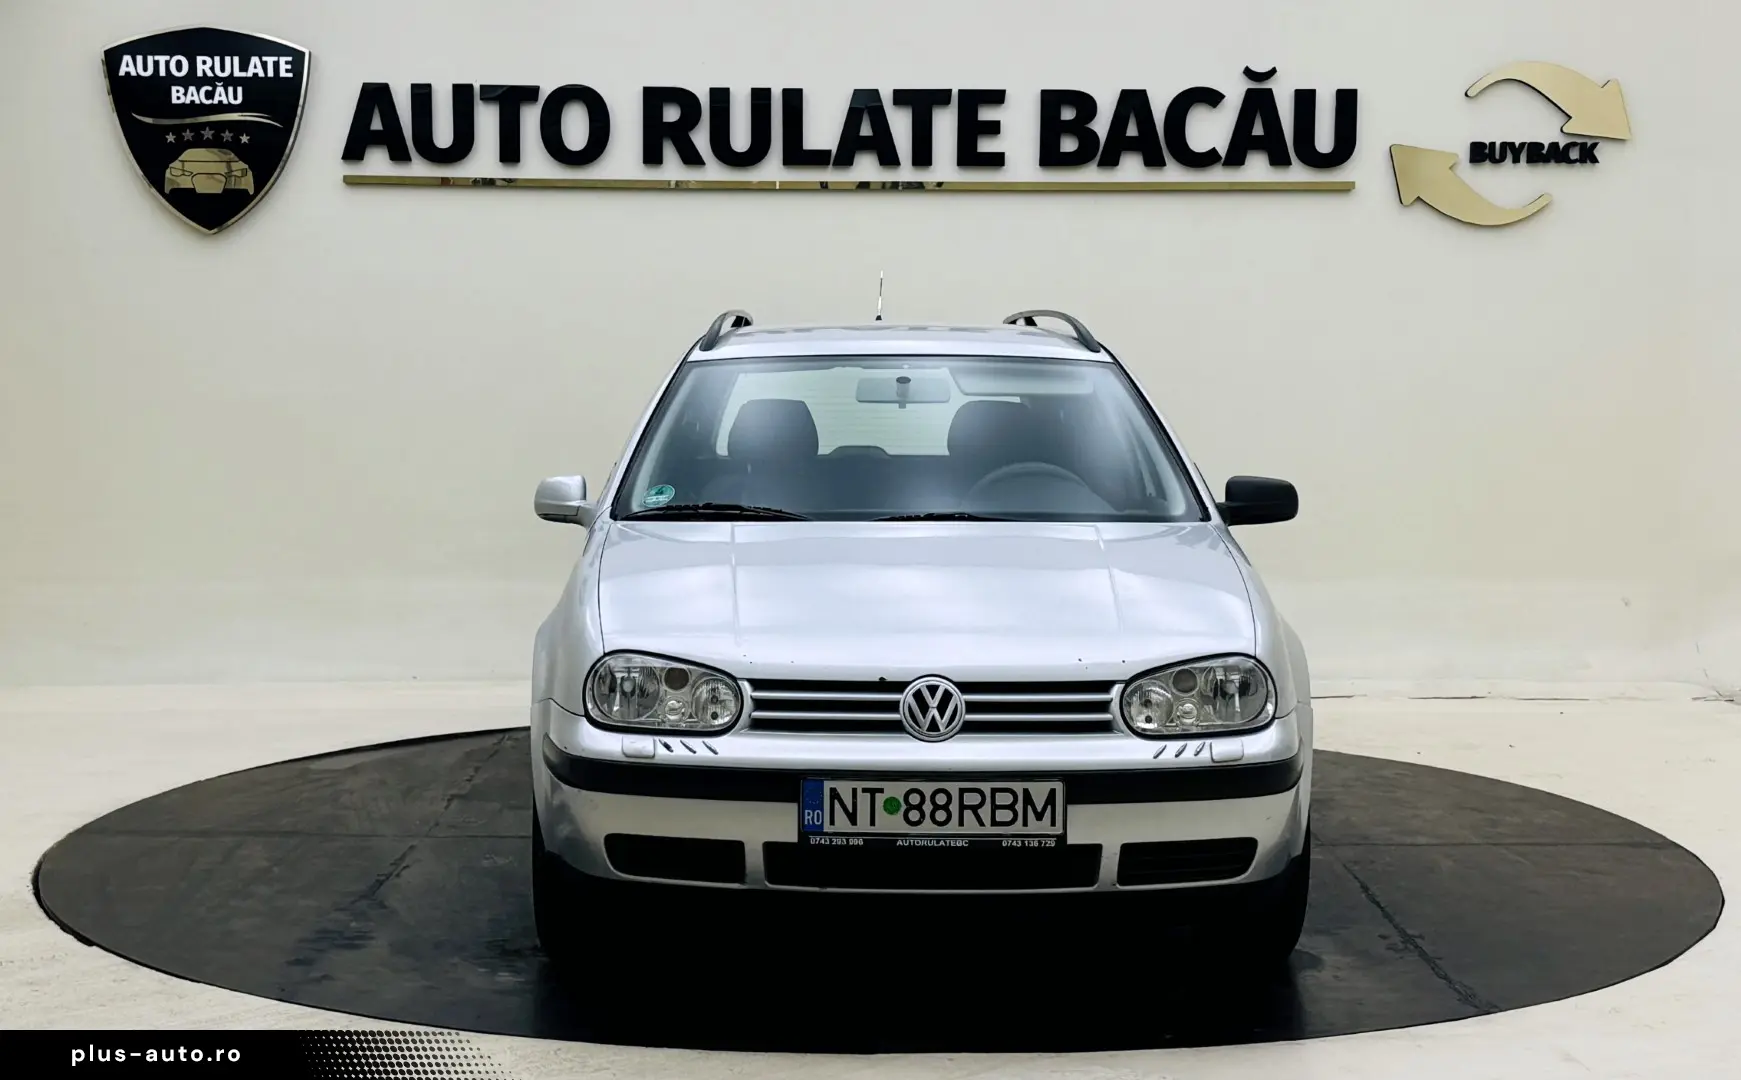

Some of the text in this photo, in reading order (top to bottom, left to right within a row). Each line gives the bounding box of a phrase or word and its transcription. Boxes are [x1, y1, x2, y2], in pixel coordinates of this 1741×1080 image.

[118, 54, 294, 78] AUTO RULATE
[171, 81, 243, 105] BACĂU
[341, 65, 1358, 168] AUTO RULATE BACĂU
[1468, 141, 1600, 164] BUYBACK
[804, 809, 823, 826] RO
[829, 787, 1057, 828] NT 88RBM
[1002, 839, 1022, 847] 0743
